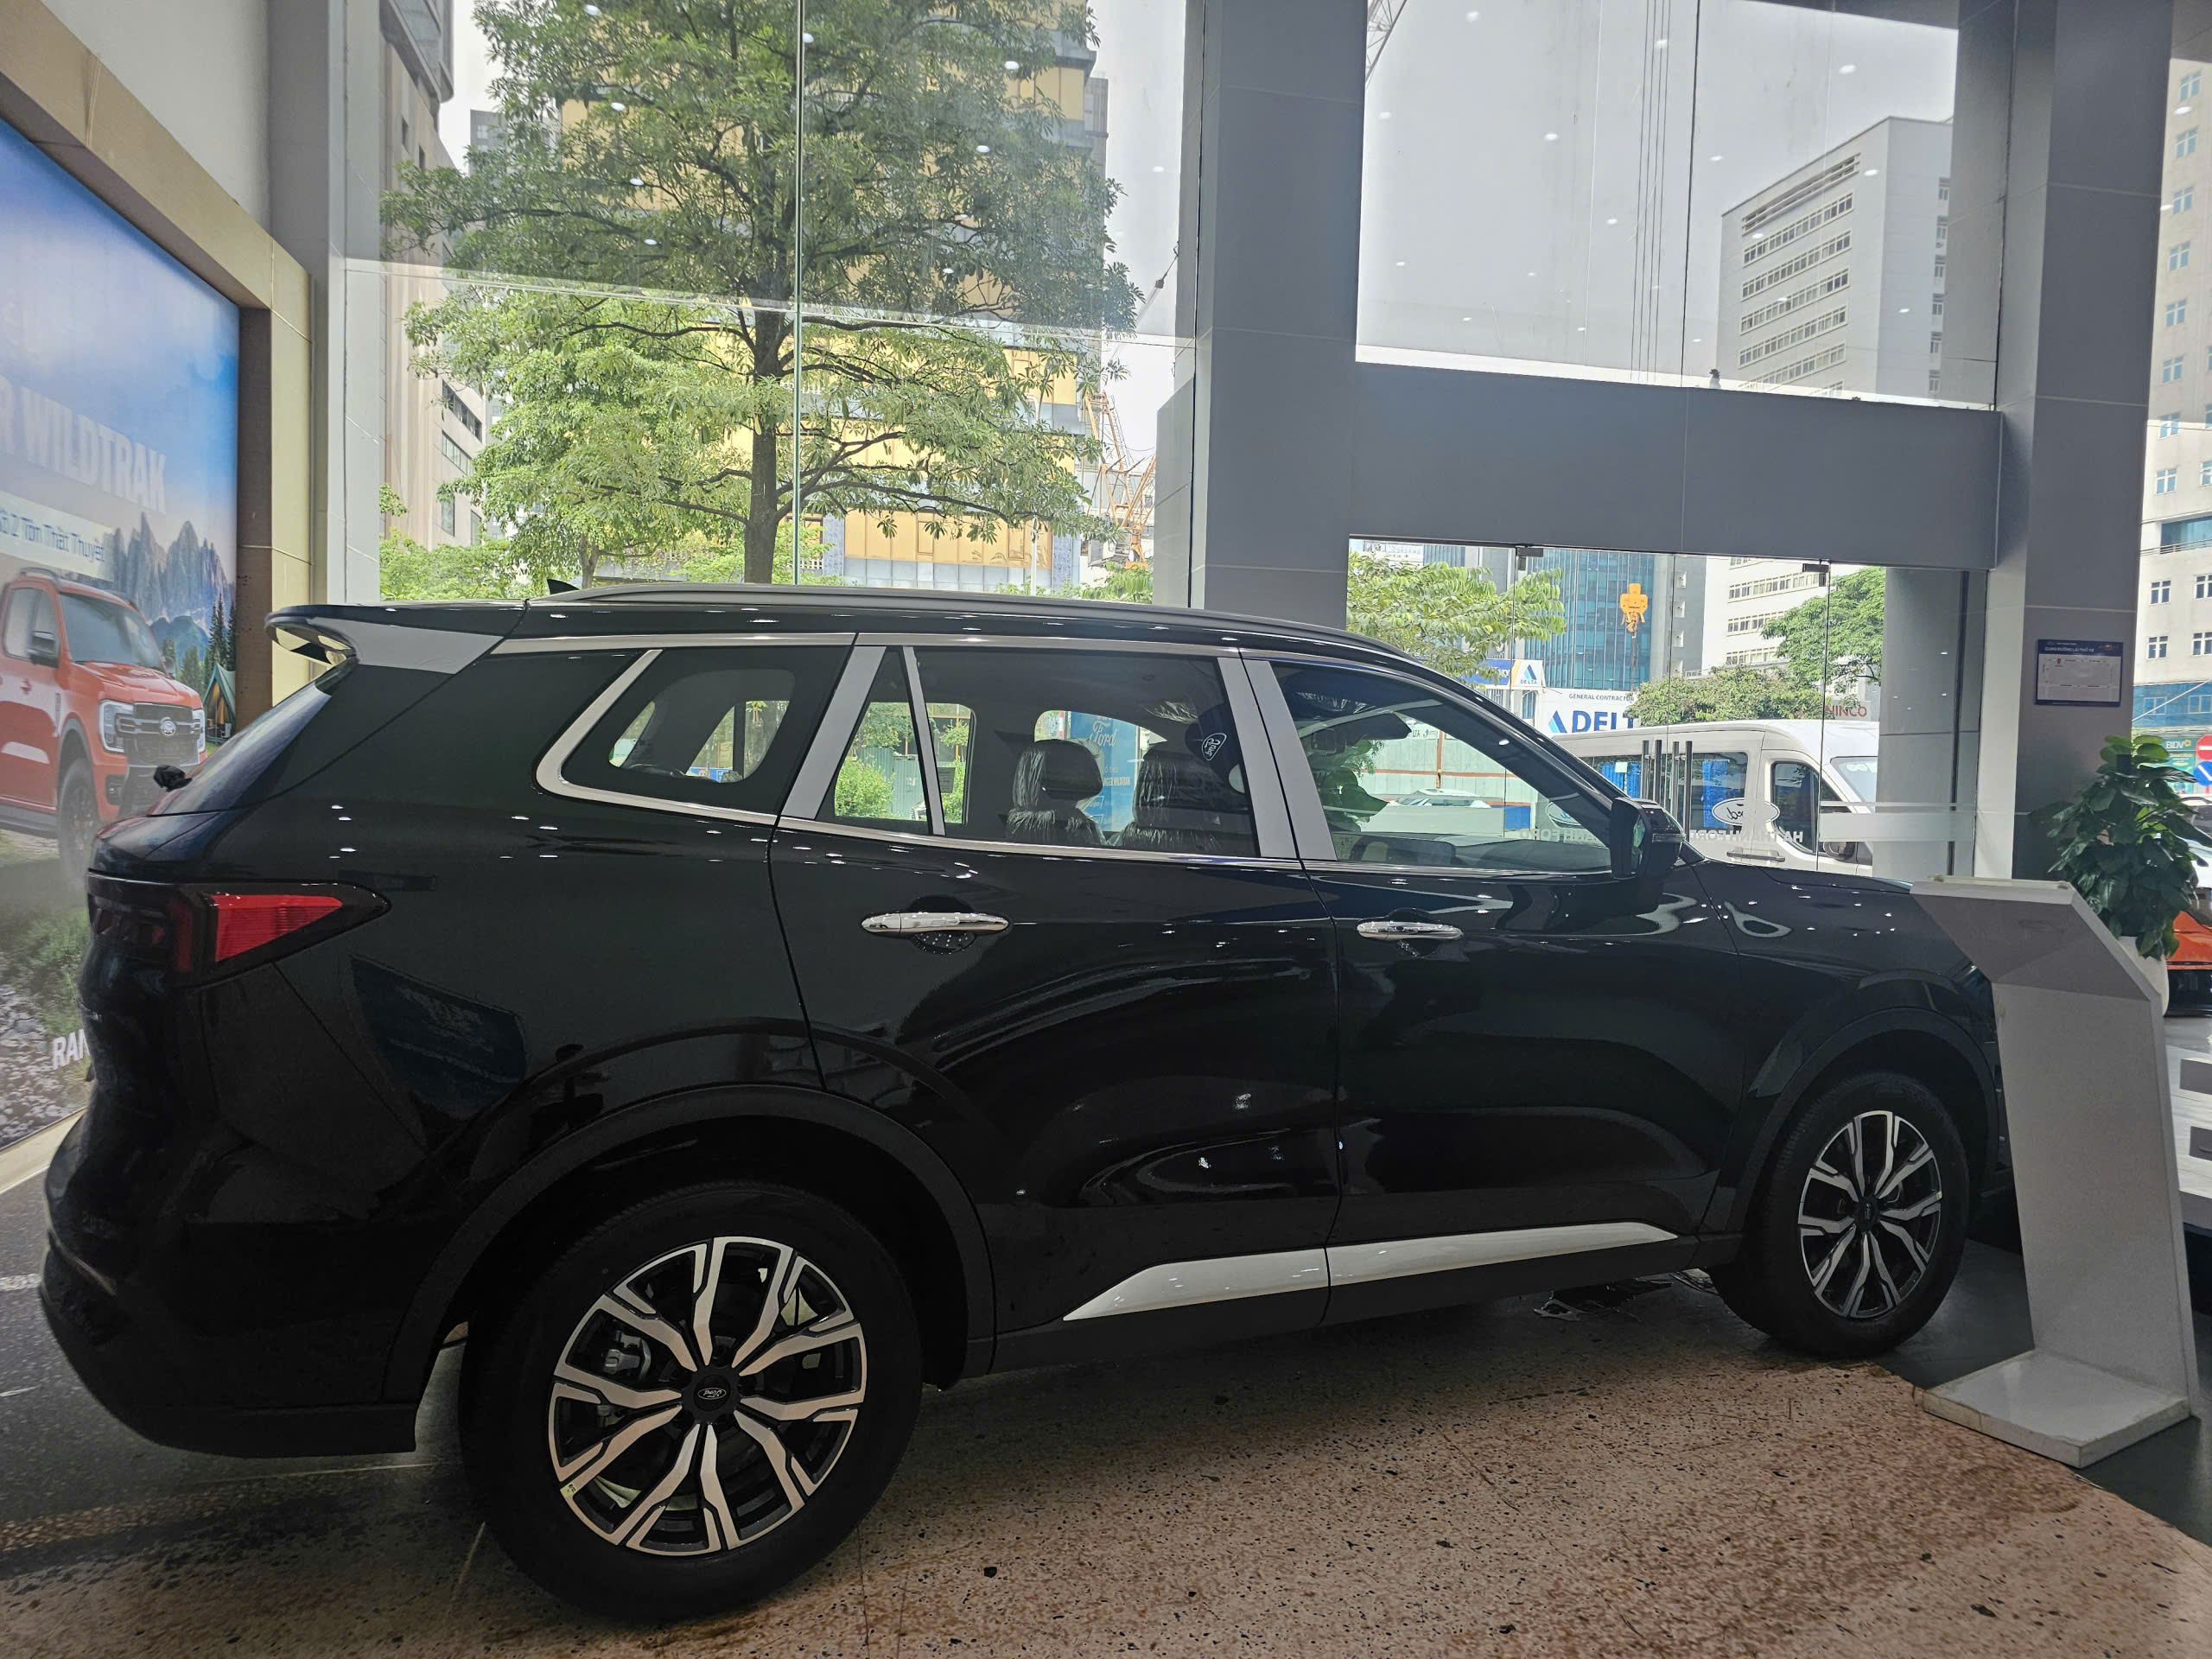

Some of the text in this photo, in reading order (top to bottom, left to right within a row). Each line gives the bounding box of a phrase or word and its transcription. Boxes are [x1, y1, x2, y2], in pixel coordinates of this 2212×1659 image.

[20, 385, 167, 517] WILDTRAK
[1090, 720, 1120, 747] Ford
[1572, 709, 1639, 734] DELT
[2165, 741, 2184, 749] BIDV
